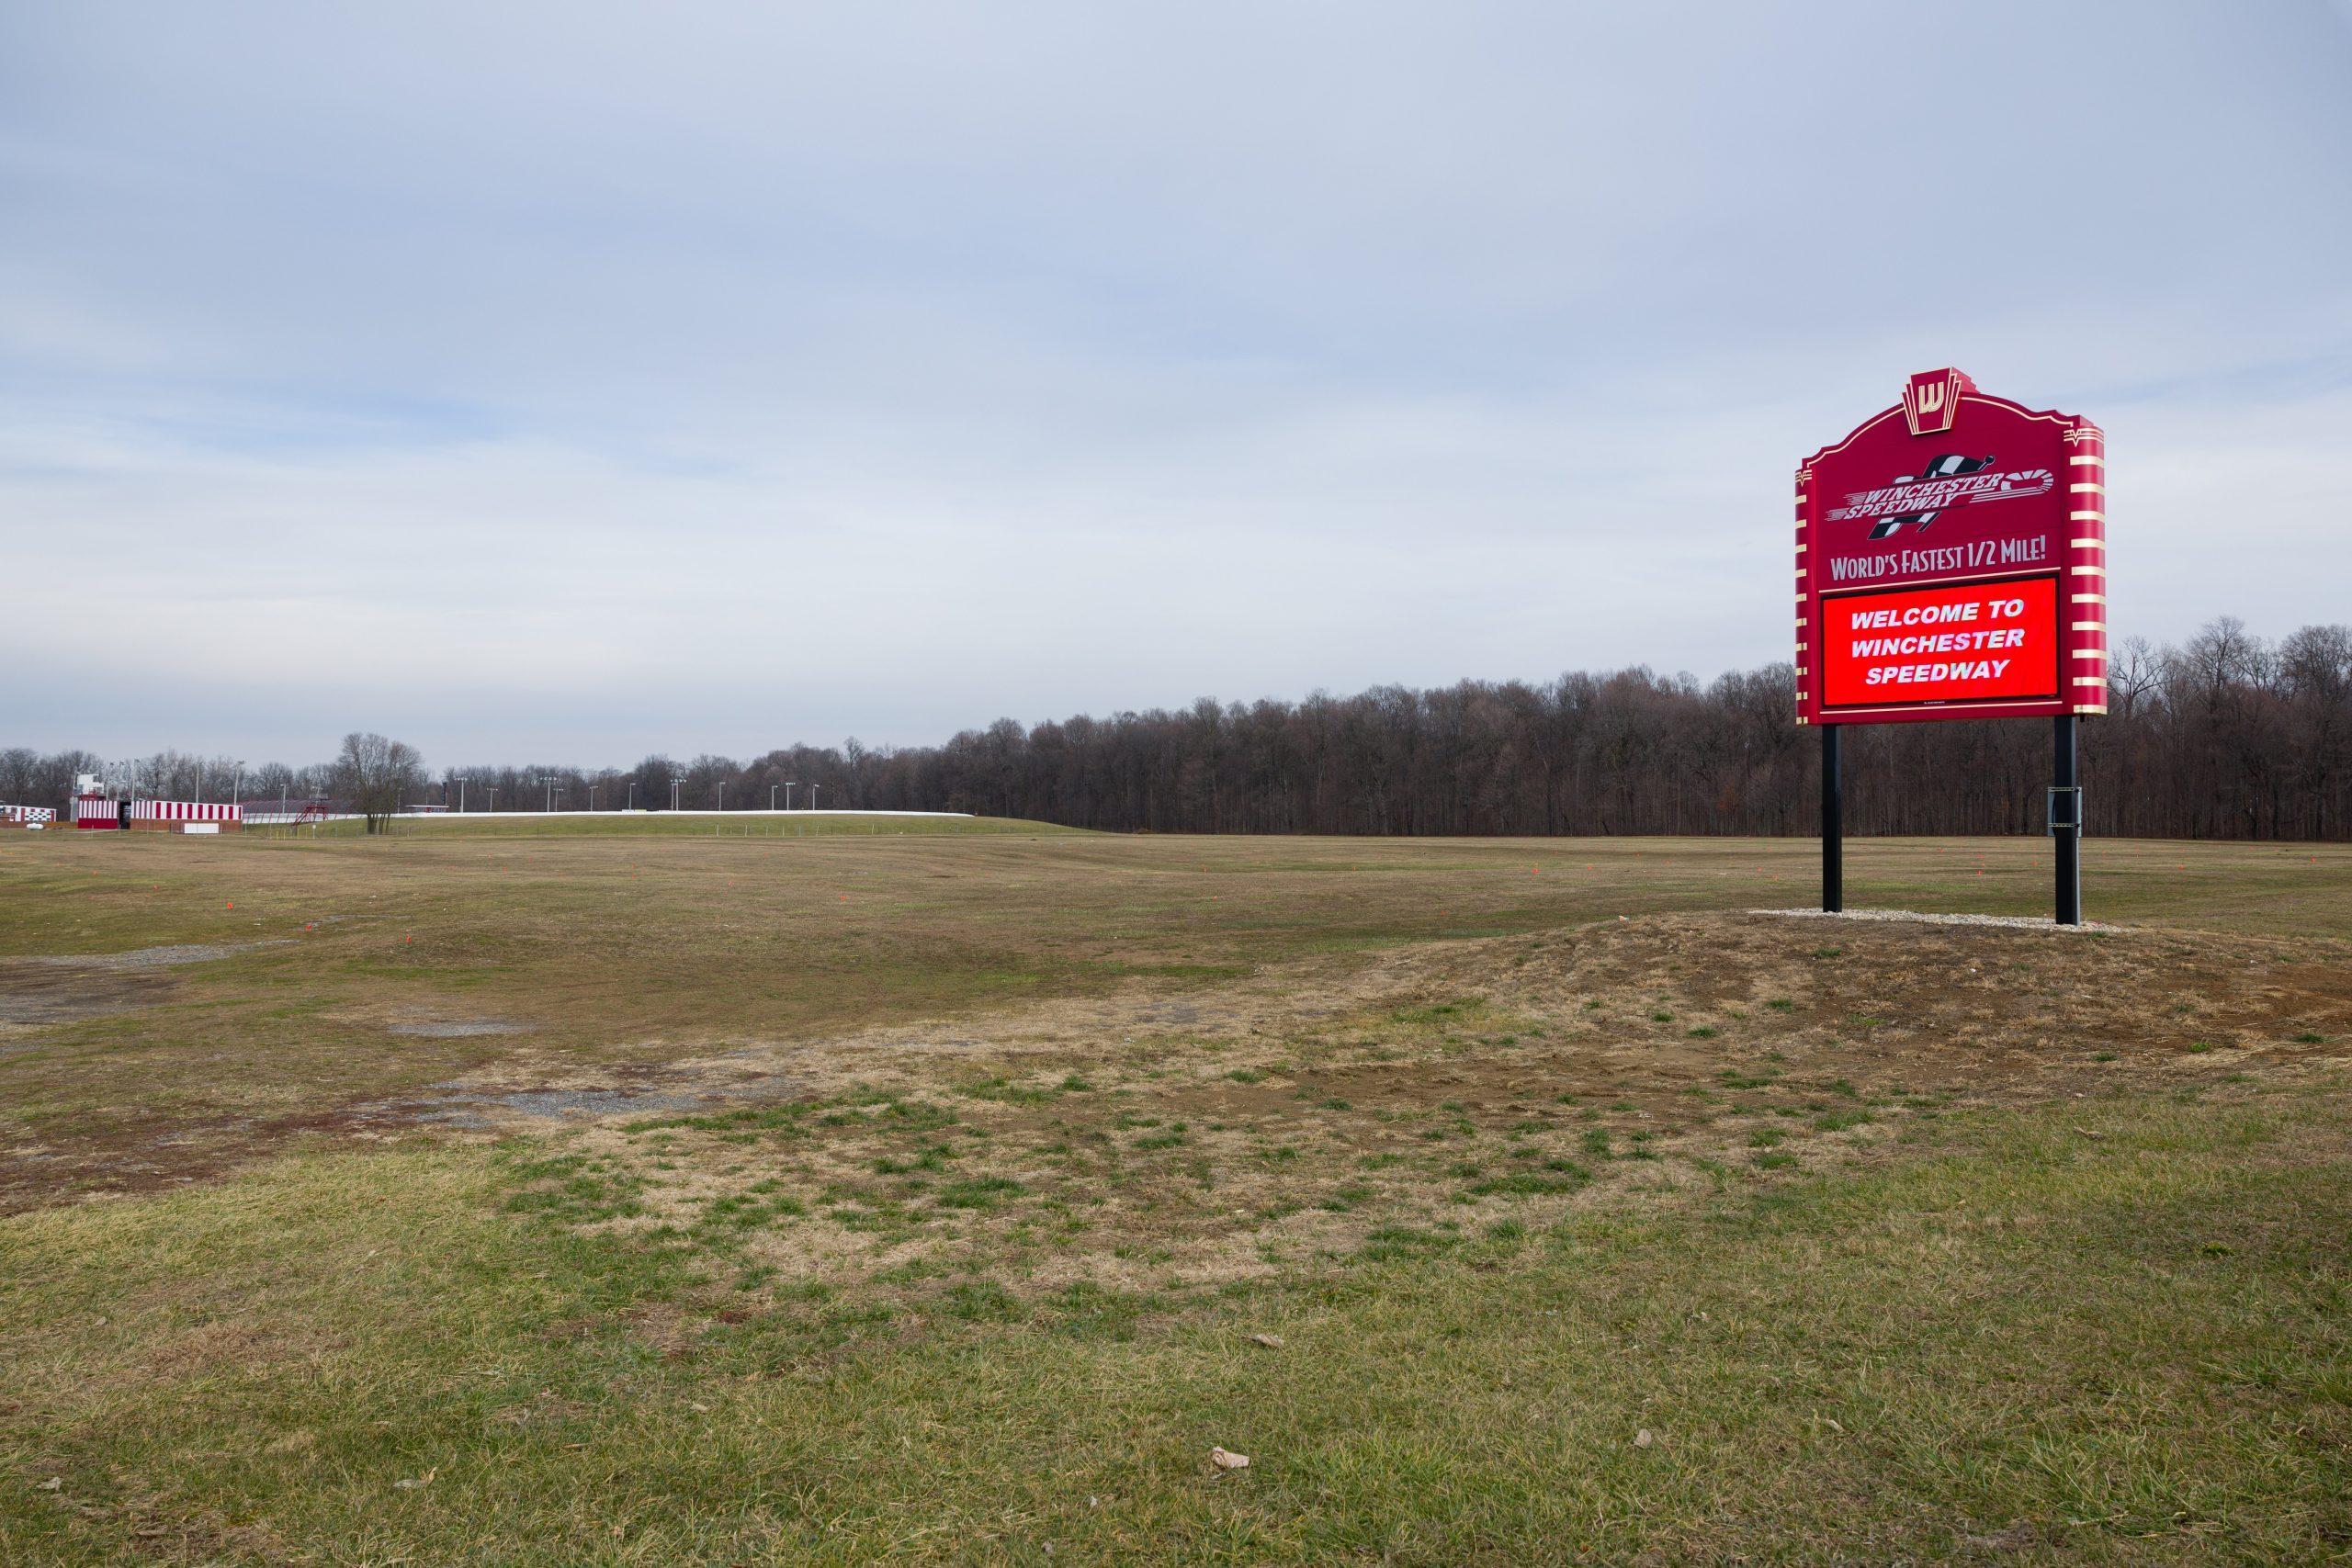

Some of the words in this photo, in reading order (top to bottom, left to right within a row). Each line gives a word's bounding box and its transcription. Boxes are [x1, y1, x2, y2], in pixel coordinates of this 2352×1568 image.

[1863, 472, 2005, 503] WINCHESTER
[1844, 491, 1960, 520] SPEEDWAY
[1830, 553, 1898, 581] WORLD'S
[1901, 546, 1963, 574] FASTEST
[1967, 540, 1996, 567] 1/2
[2000, 535, 2046, 564] MILE!
[1851, 602, 1980, 630] WELCOME
[1988, 599, 2025, 619] TO
[1851, 628, 2025, 658] WINCHESTER
[1865, 659, 2011, 685] SPEEDWAY
